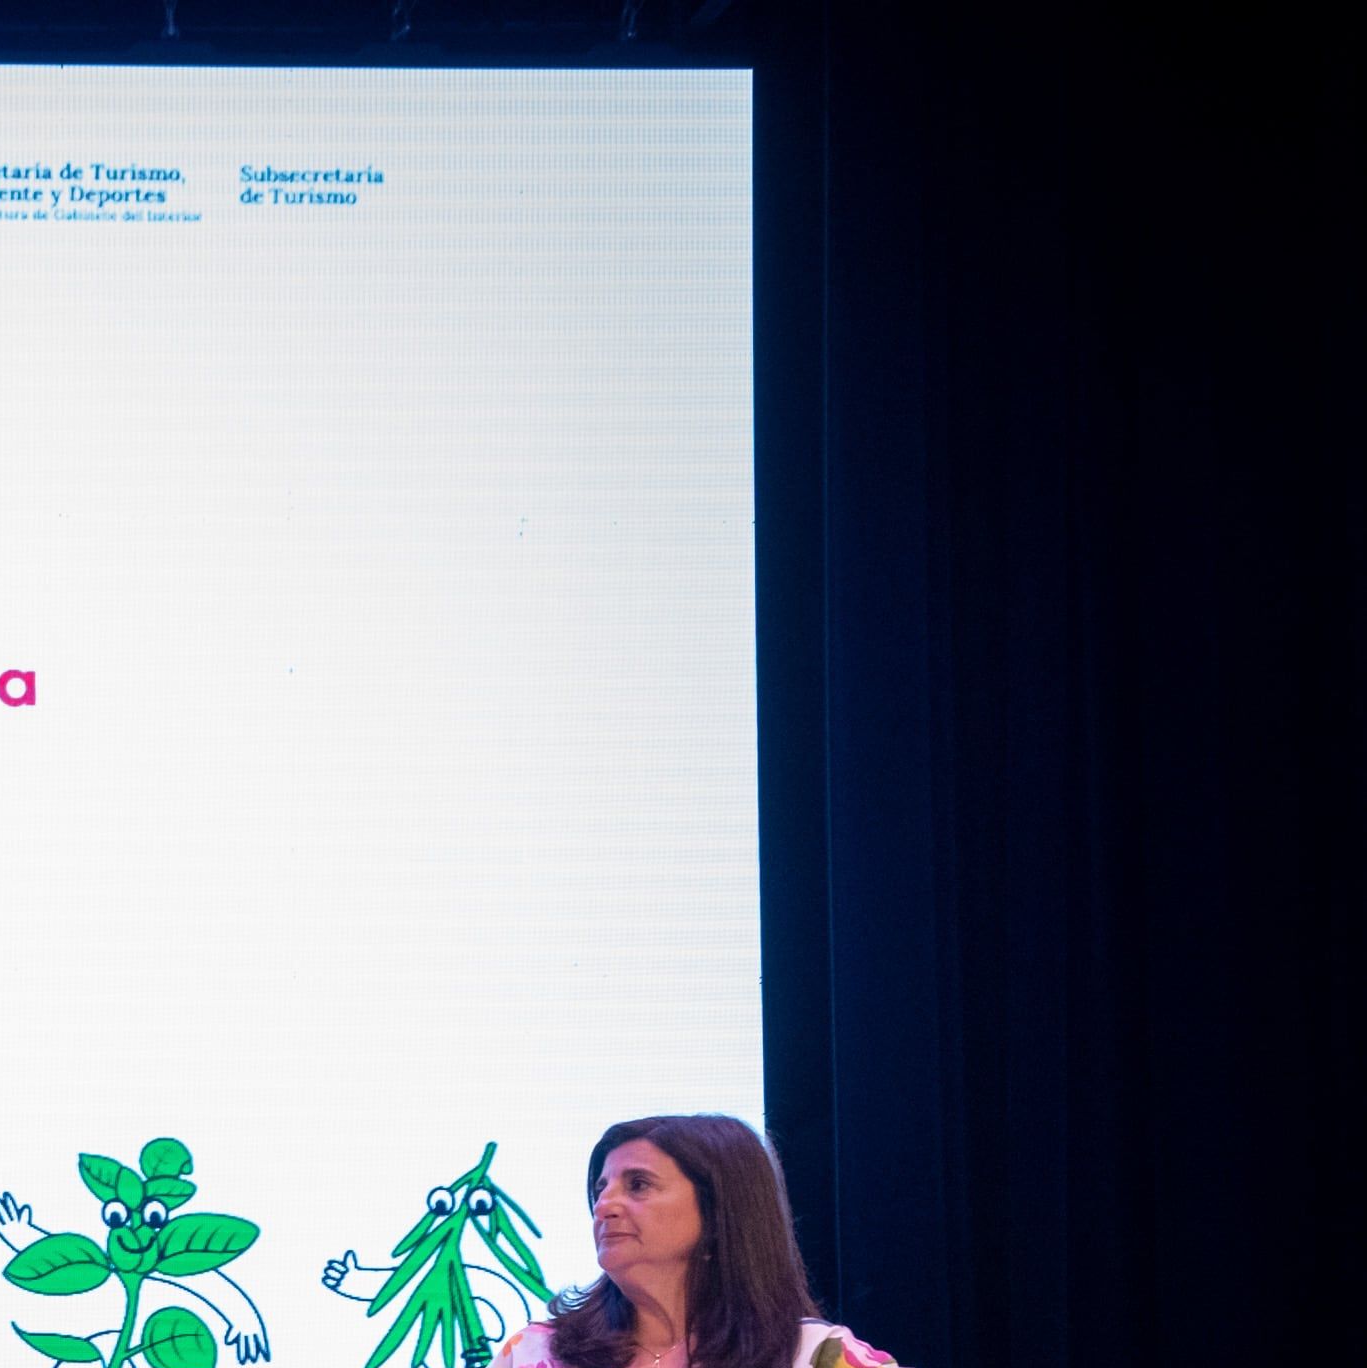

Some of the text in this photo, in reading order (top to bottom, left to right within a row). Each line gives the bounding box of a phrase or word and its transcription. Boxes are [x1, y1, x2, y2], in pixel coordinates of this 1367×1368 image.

[58, 161, 84, 182] de
[90, 162, 187, 186] Turismo,
[240, 164, 385, 185] Subsecretaría
[50, 189, 62, 208] y
[69, 184, 168, 208] Deportes
[239, 186, 359, 207] de Turismo
